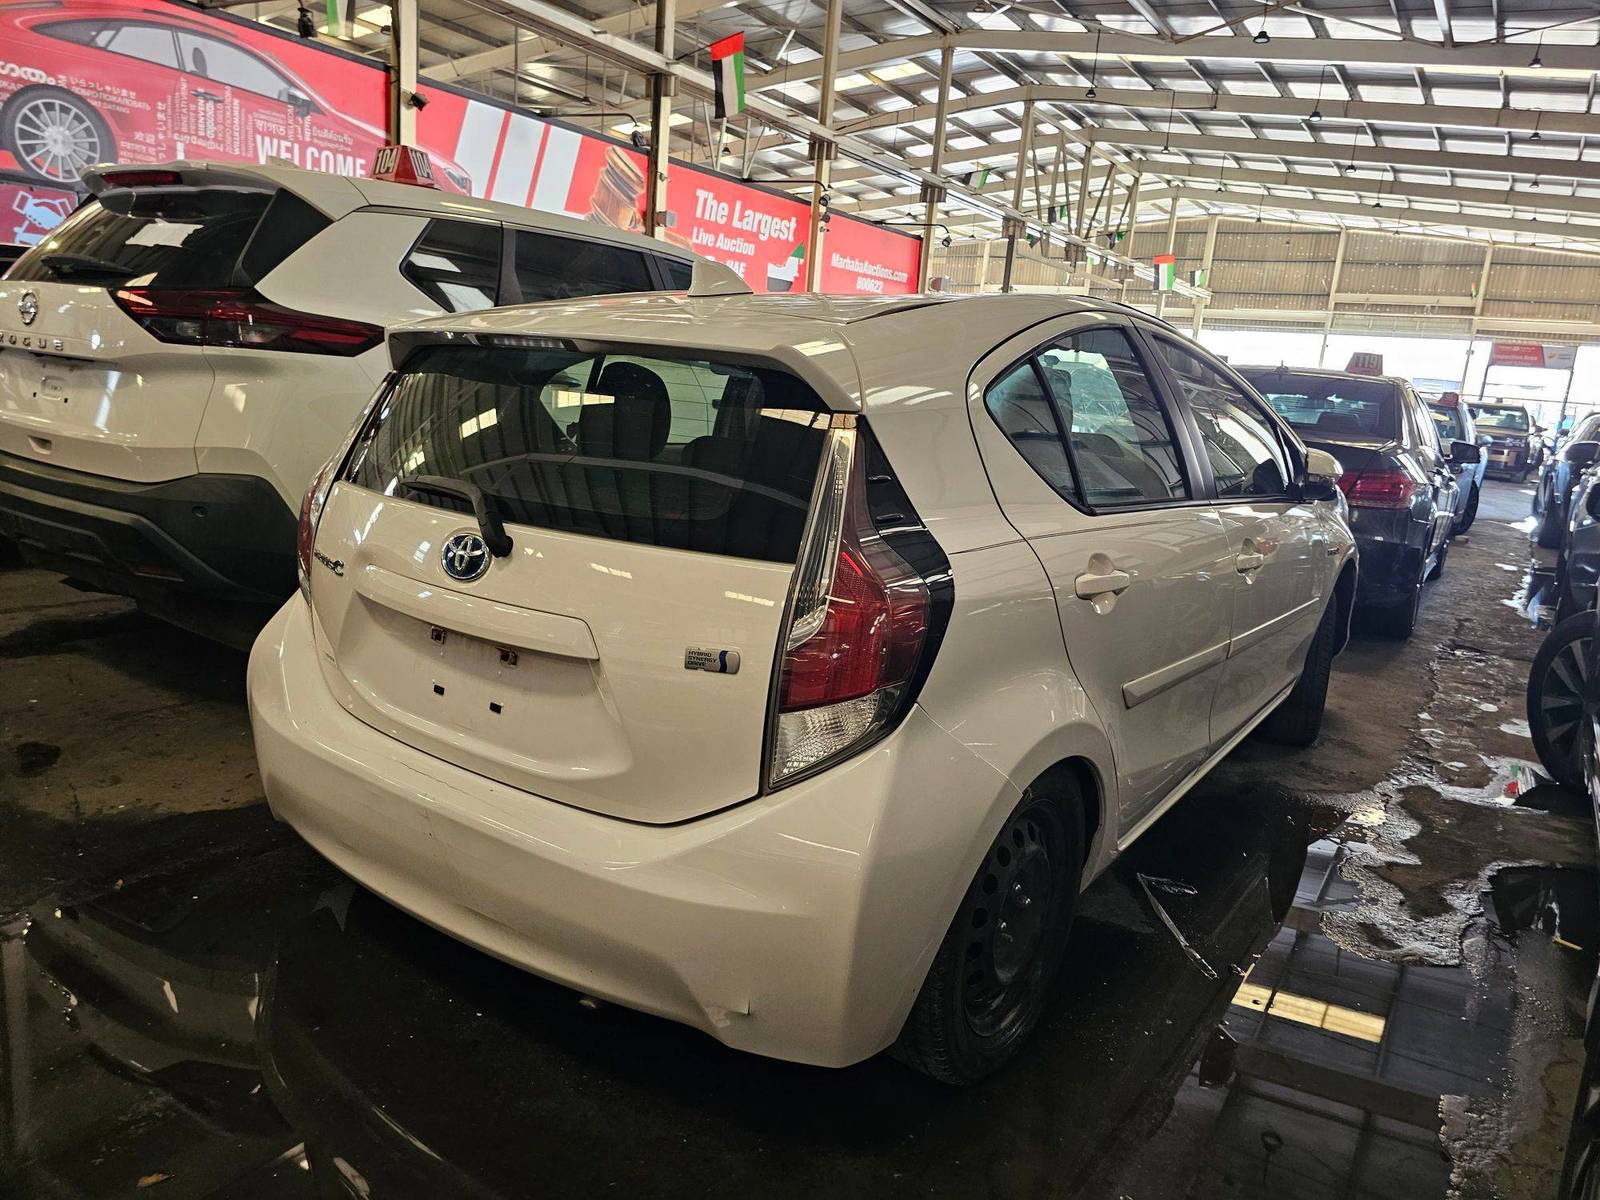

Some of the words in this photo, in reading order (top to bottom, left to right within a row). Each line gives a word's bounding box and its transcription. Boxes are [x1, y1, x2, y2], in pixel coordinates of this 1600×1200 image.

[256, 134, 366, 178] WELCOME
[375, 147, 397, 174] 104
[695, 188, 728, 225] The
[732, 199, 797, 242] Largest
[691, 226, 716, 247] Live
[716, 232, 755, 256] Auction
